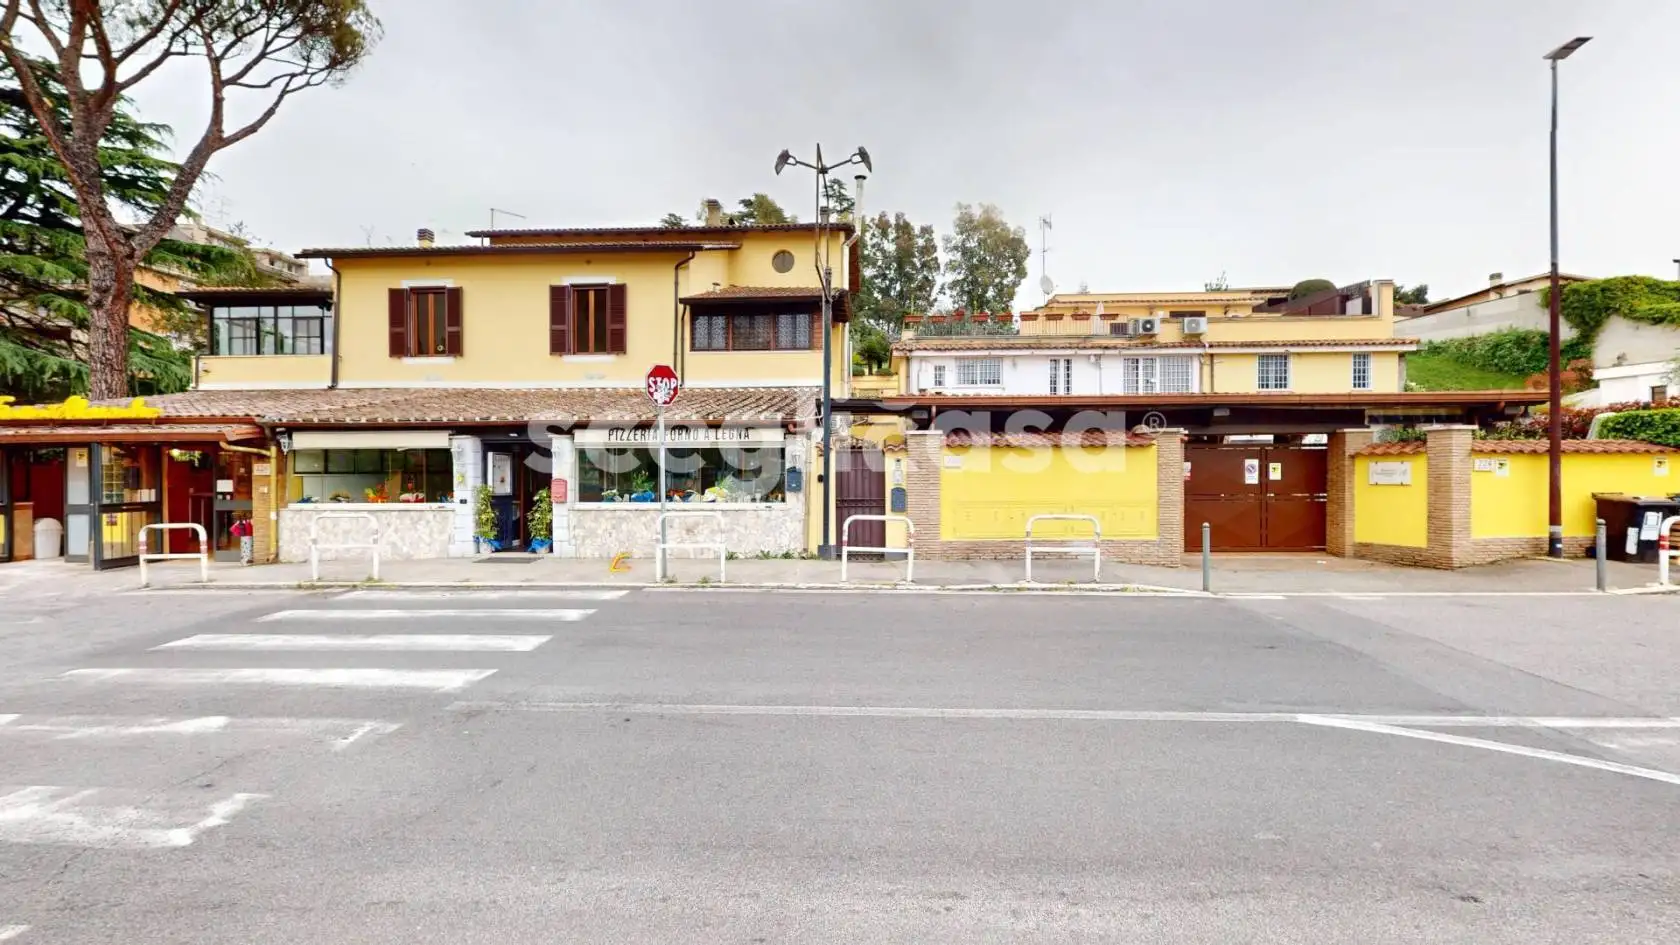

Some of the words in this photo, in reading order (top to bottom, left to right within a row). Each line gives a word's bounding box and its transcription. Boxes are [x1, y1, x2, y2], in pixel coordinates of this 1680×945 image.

[648, 377, 677, 392] STOP
[608, 427, 658, 442] PIZZERIA
[703, 428, 711, 441] A
[716, 428, 750, 441] LEGNA
